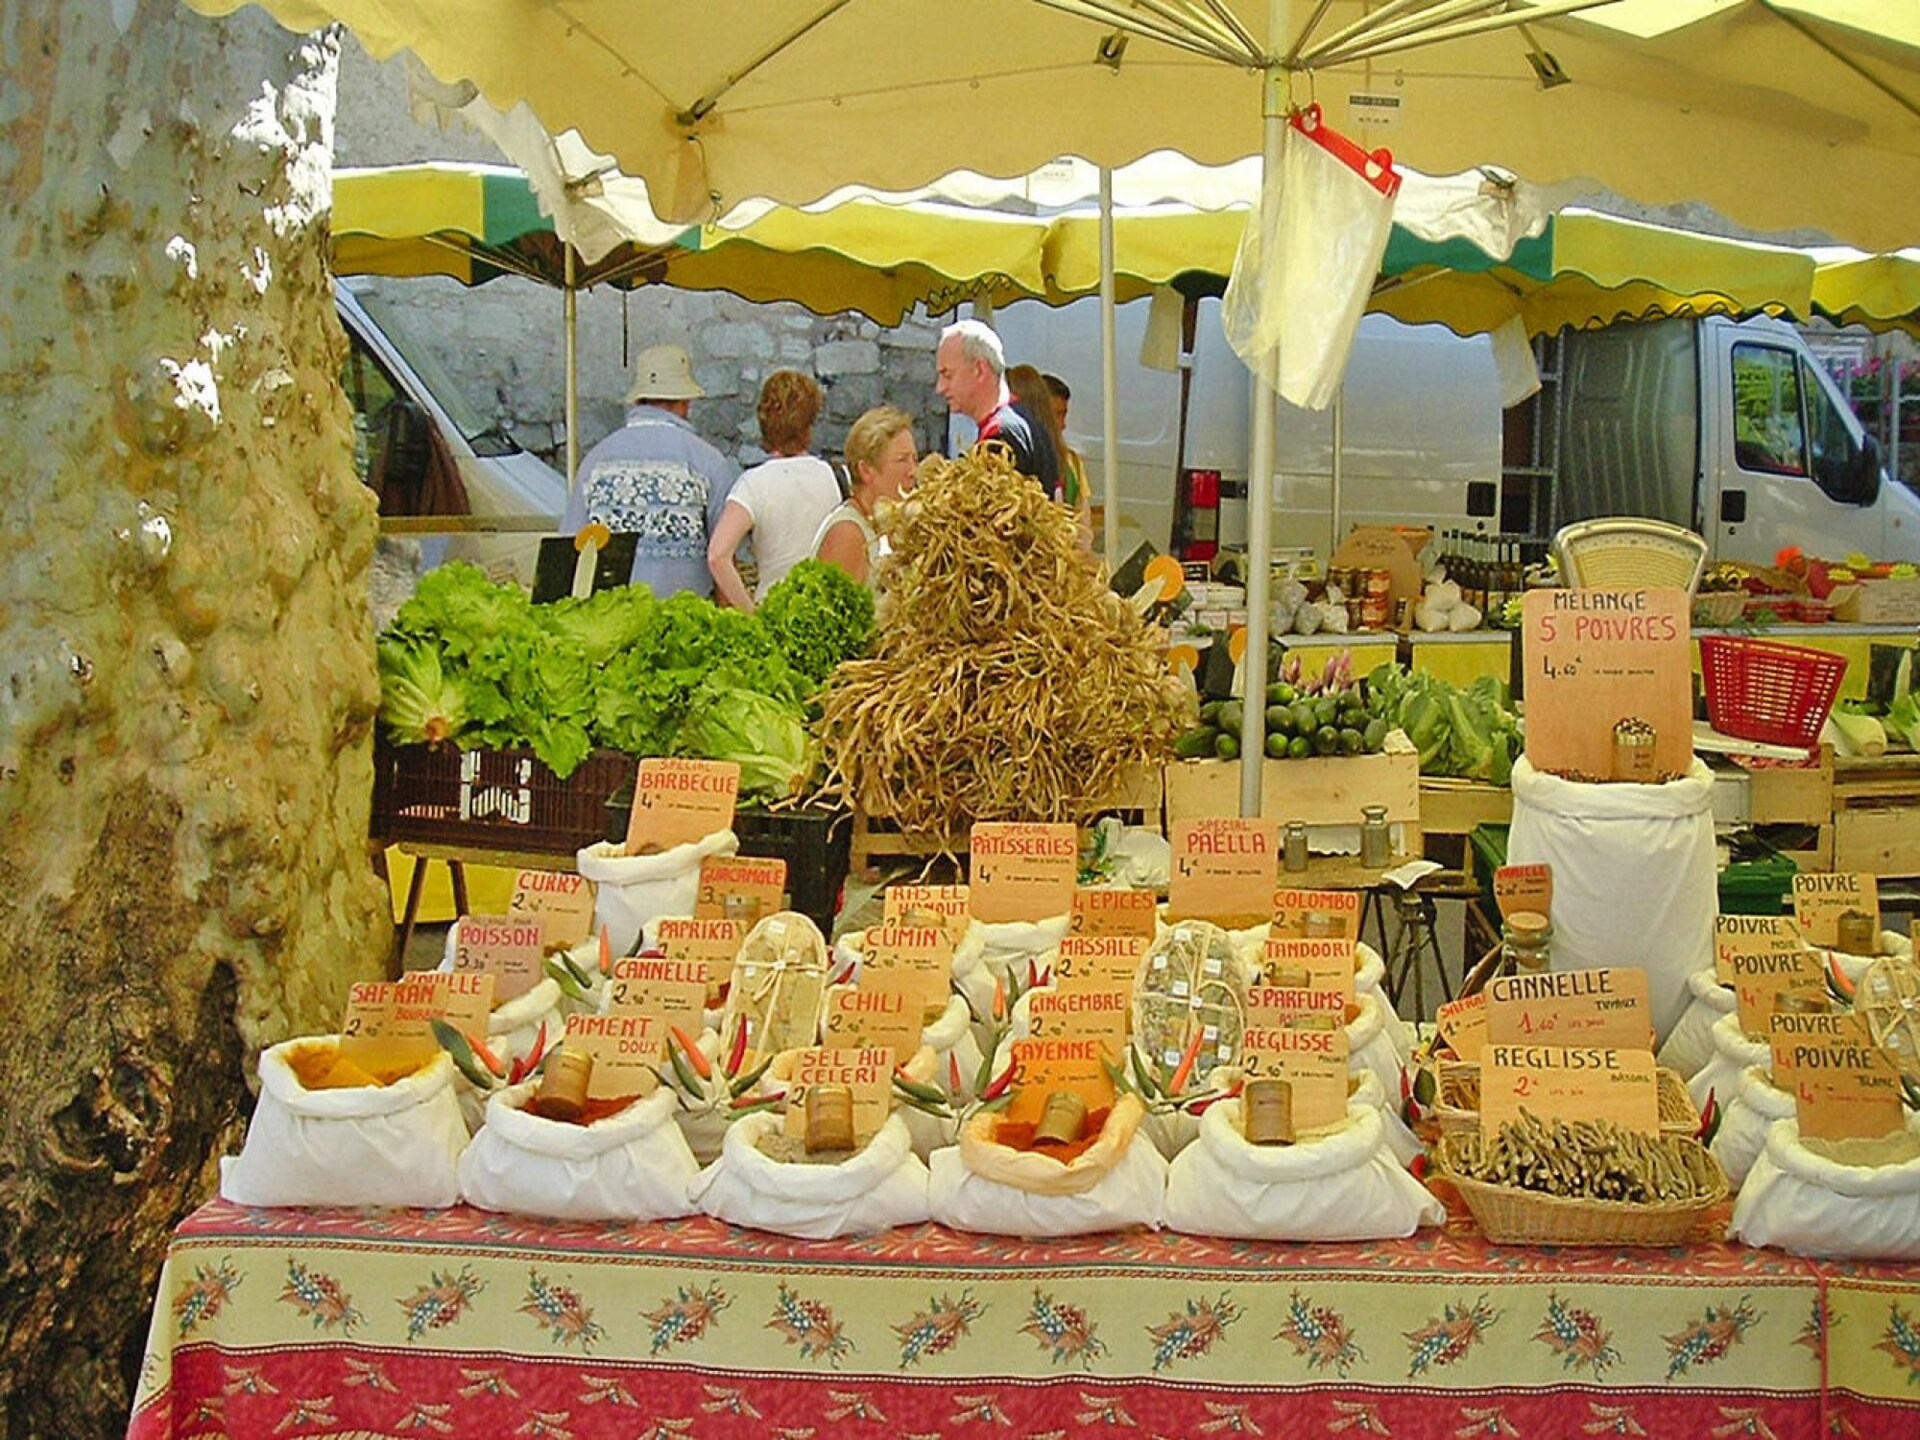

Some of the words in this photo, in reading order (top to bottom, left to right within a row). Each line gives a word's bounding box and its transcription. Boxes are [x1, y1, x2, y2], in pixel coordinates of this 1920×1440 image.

[1540, 615, 1556, 642] 5
[1575, 615, 1677, 642] POIVRES
[640, 772, 736, 794] BARBECUE
[518, 872, 581, 894] CURRY
[701, 867, 782, 886] GUACAMOLE
[1795, 874, 1860, 893] POIVRE
[940, 886, 963, 900] EL
[1273, 891, 1356, 910] COLOMBO
[460, 926, 540, 946] POISSON
[659, 920, 733, 940] PAPRIKA
[1716, 916, 1784, 935] POIVRE
[866, 926, 938, 948] CUMIN
[1265, 940, 1351, 958] TANDOORI
[614, 961, 708, 984] CANNELLE
[1734, 952, 1805, 975] POIVRE
[1492, 970, 1614, 1002] CANNELLE
[840, 992, 903, 1014] CHILI
[1030, 991, 1125, 1015] GINGEMBRE
[1263, 988, 1345, 1011] PARFUMS
[566, 1014, 653, 1038] PIMENT
[1771, 1013, 1845, 1036] POIVRE
[618, 1040, 658, 1054] DOUX
[1011, 1039, 1096, 1061] CAYENNE
[1794, 1045, 1876, 1070] POIVRE
[803, 1050, 845, 1067] SEL
[858, 1050, 887, 1067] AU
[1494, 1048, 1621, 1070] REGLISSE
